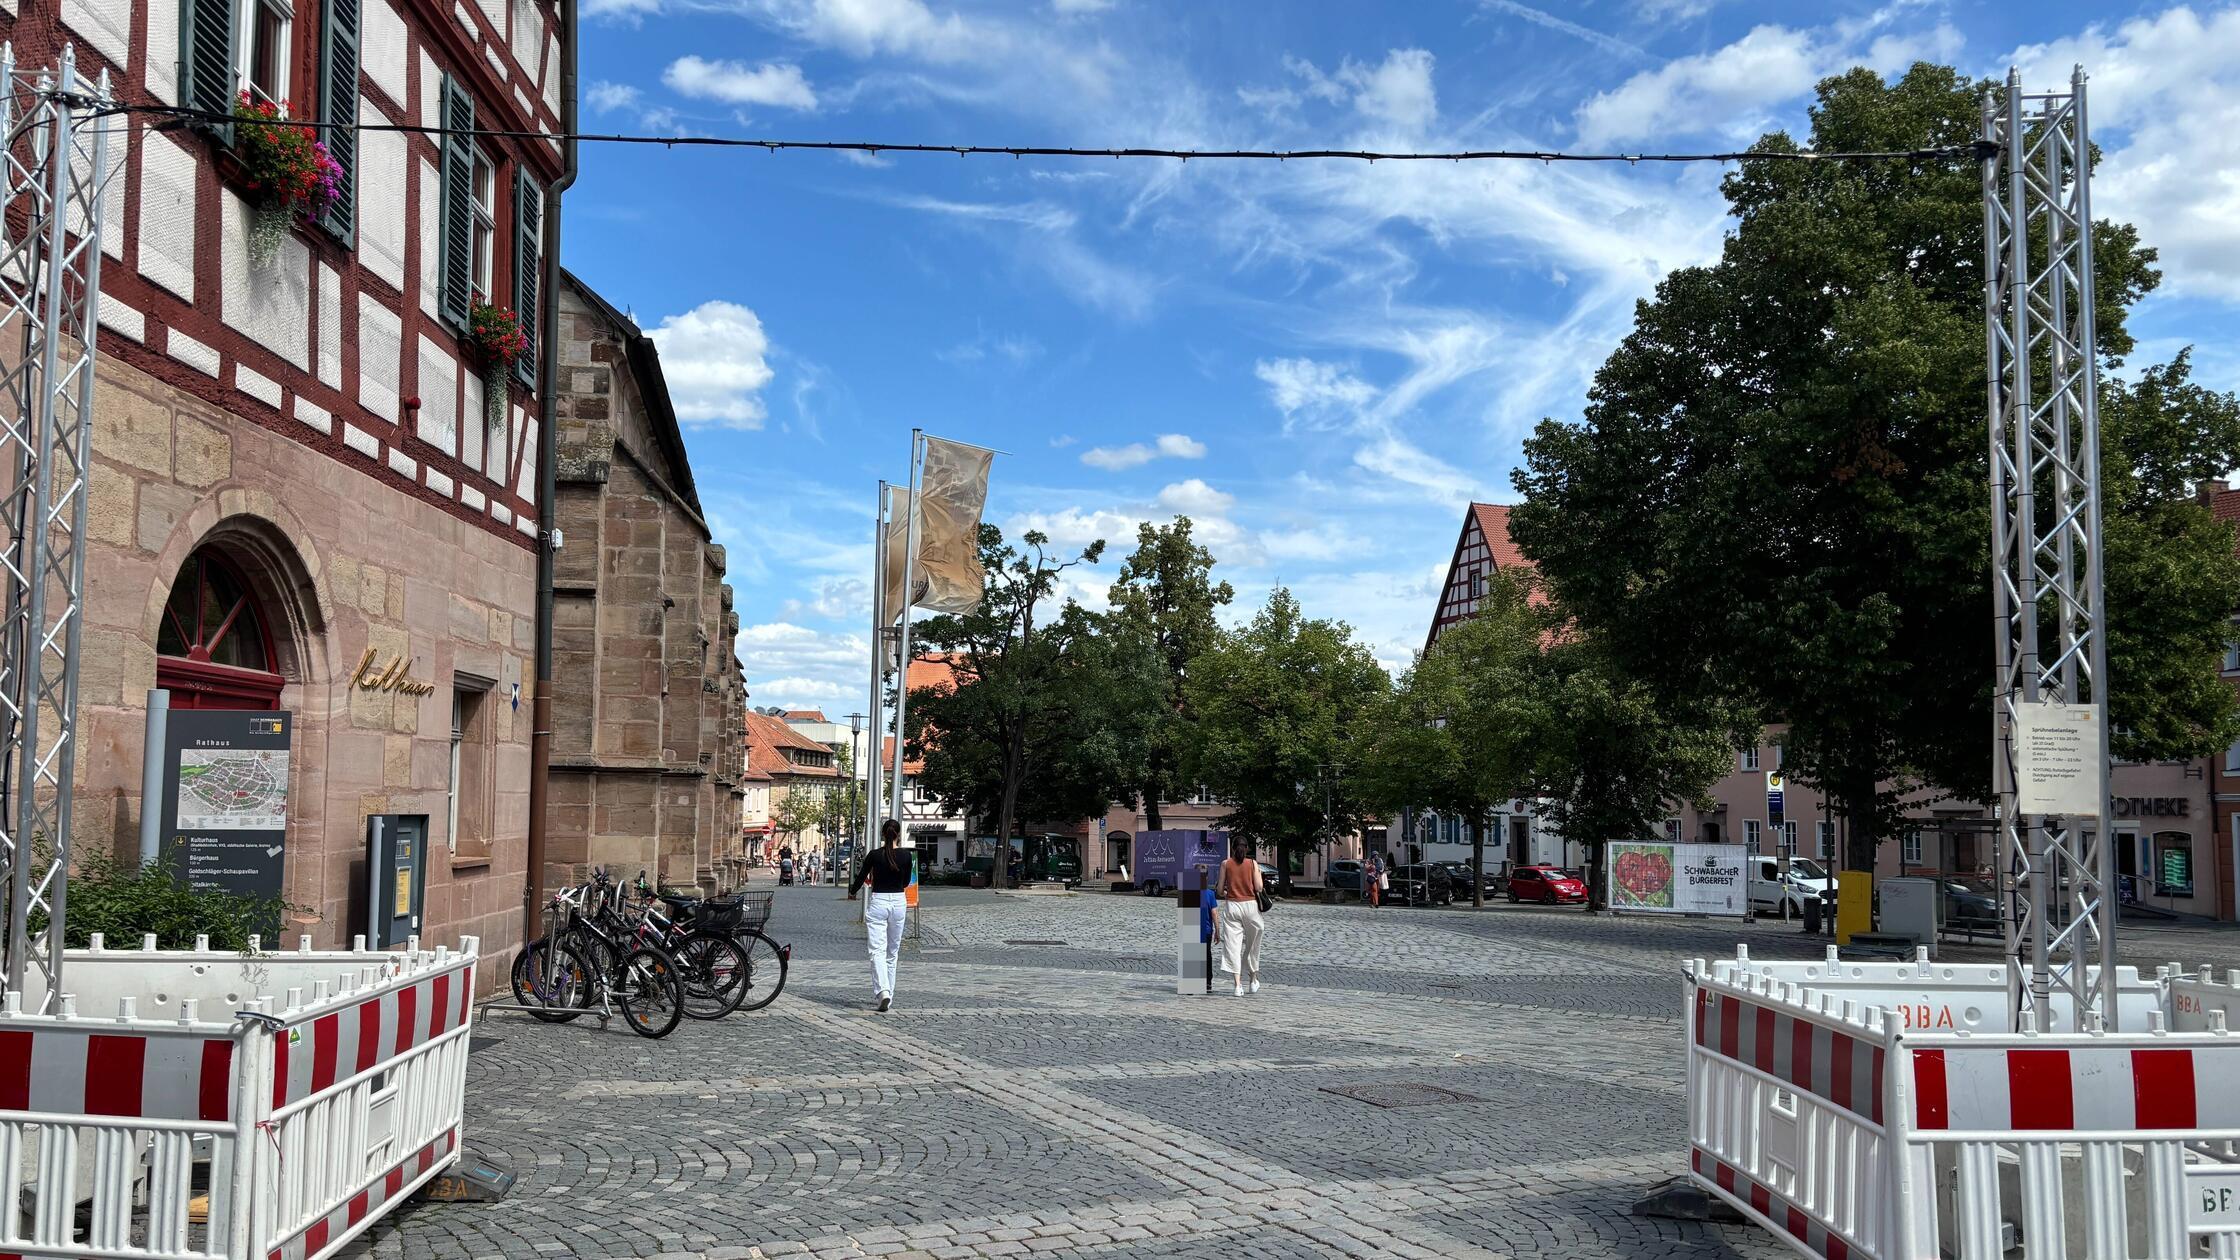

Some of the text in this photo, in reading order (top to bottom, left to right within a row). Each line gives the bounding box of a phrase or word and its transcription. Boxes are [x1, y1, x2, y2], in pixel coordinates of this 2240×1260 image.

[348, 648, 435, 698] Rathaus
[2110, 797, 2190, 817] OTHEKE
[1684, 865, 1739, 876] SCHWABACHER
[1689, 875, 1734, 887] BÜRGERFEST
[2177, 994, 2201, 1015] BBA
[1897, 1005, 1954, 1029] BBA
[2202, 1187, 2240, 1213] BB
